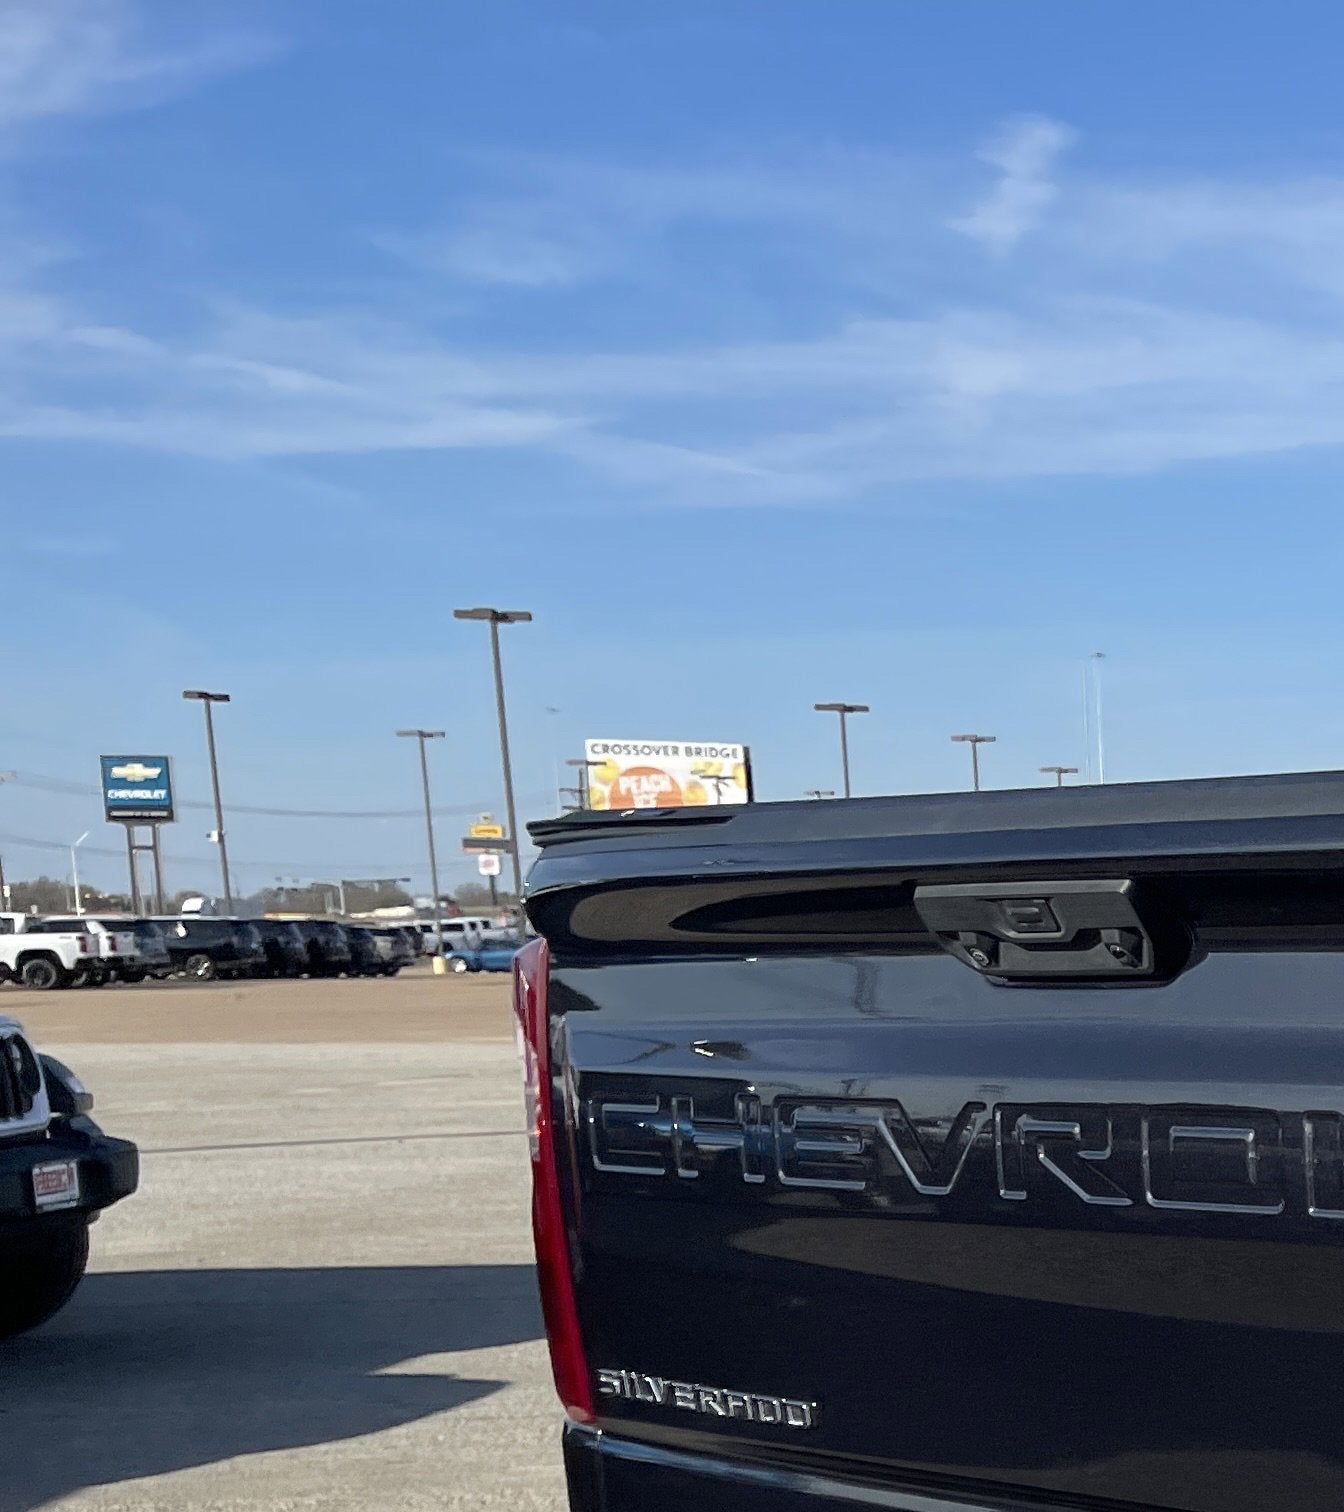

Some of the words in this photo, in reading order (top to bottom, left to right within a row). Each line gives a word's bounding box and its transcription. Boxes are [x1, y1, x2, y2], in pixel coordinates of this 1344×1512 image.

[590, 742, 680, 757] CROSSOVER
[684, 745, 739, 759] BRIDGE
[107, 789, 167, 800] CHEVROLET
[598, 1369, 818, 1429] SILVERADO
